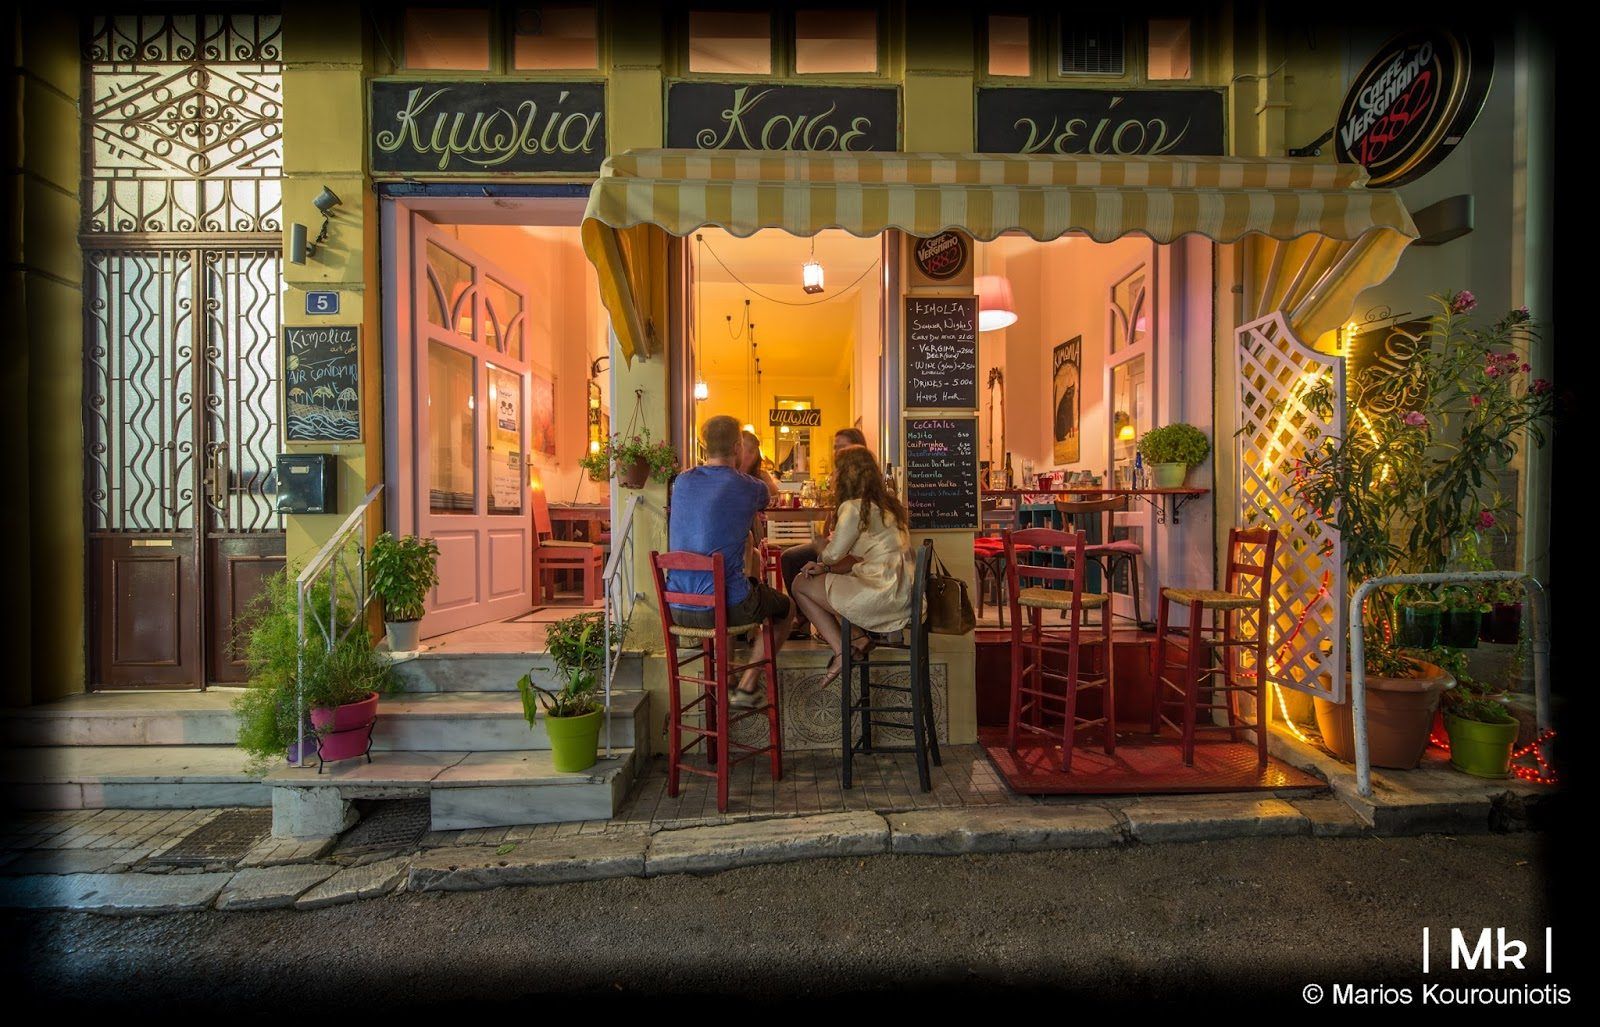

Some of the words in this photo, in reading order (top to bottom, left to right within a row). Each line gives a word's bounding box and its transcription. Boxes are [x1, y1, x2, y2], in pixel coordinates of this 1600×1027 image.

[1341, 41, 1432, 150] VERGNANO
[1360, 70, 1432, 166] 1882
[376, 86, 601, 170] Κιμωλία
[317, 295, 328, 310] 5
[916, 302, 965, 316] KIMOLIA
[288, 329, 352, 353] Kimolia
